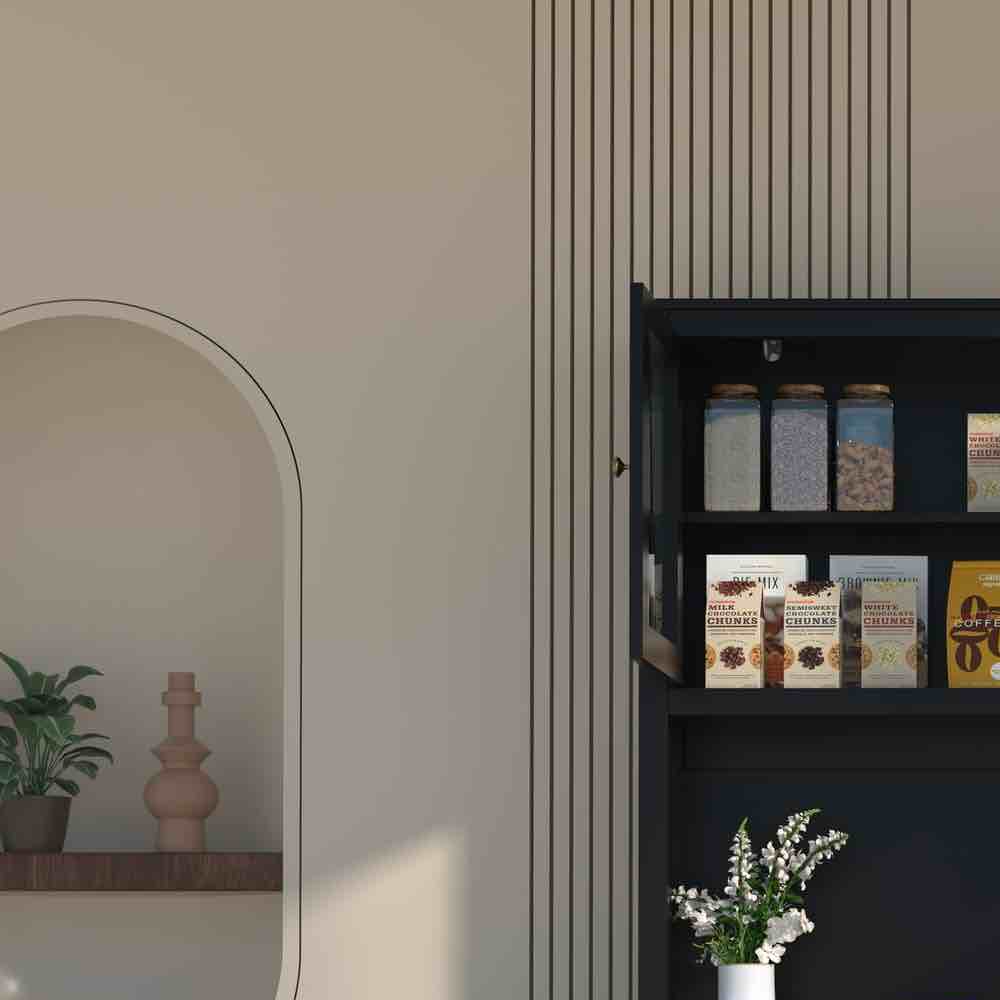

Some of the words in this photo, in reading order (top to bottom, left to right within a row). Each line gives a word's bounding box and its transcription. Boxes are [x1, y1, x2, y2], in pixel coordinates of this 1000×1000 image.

[707, 617, 758, 625] CHUNKS
[785, 617, 838, 625] CHUNKS
[863, 617, 915, 625] CHUNKS
